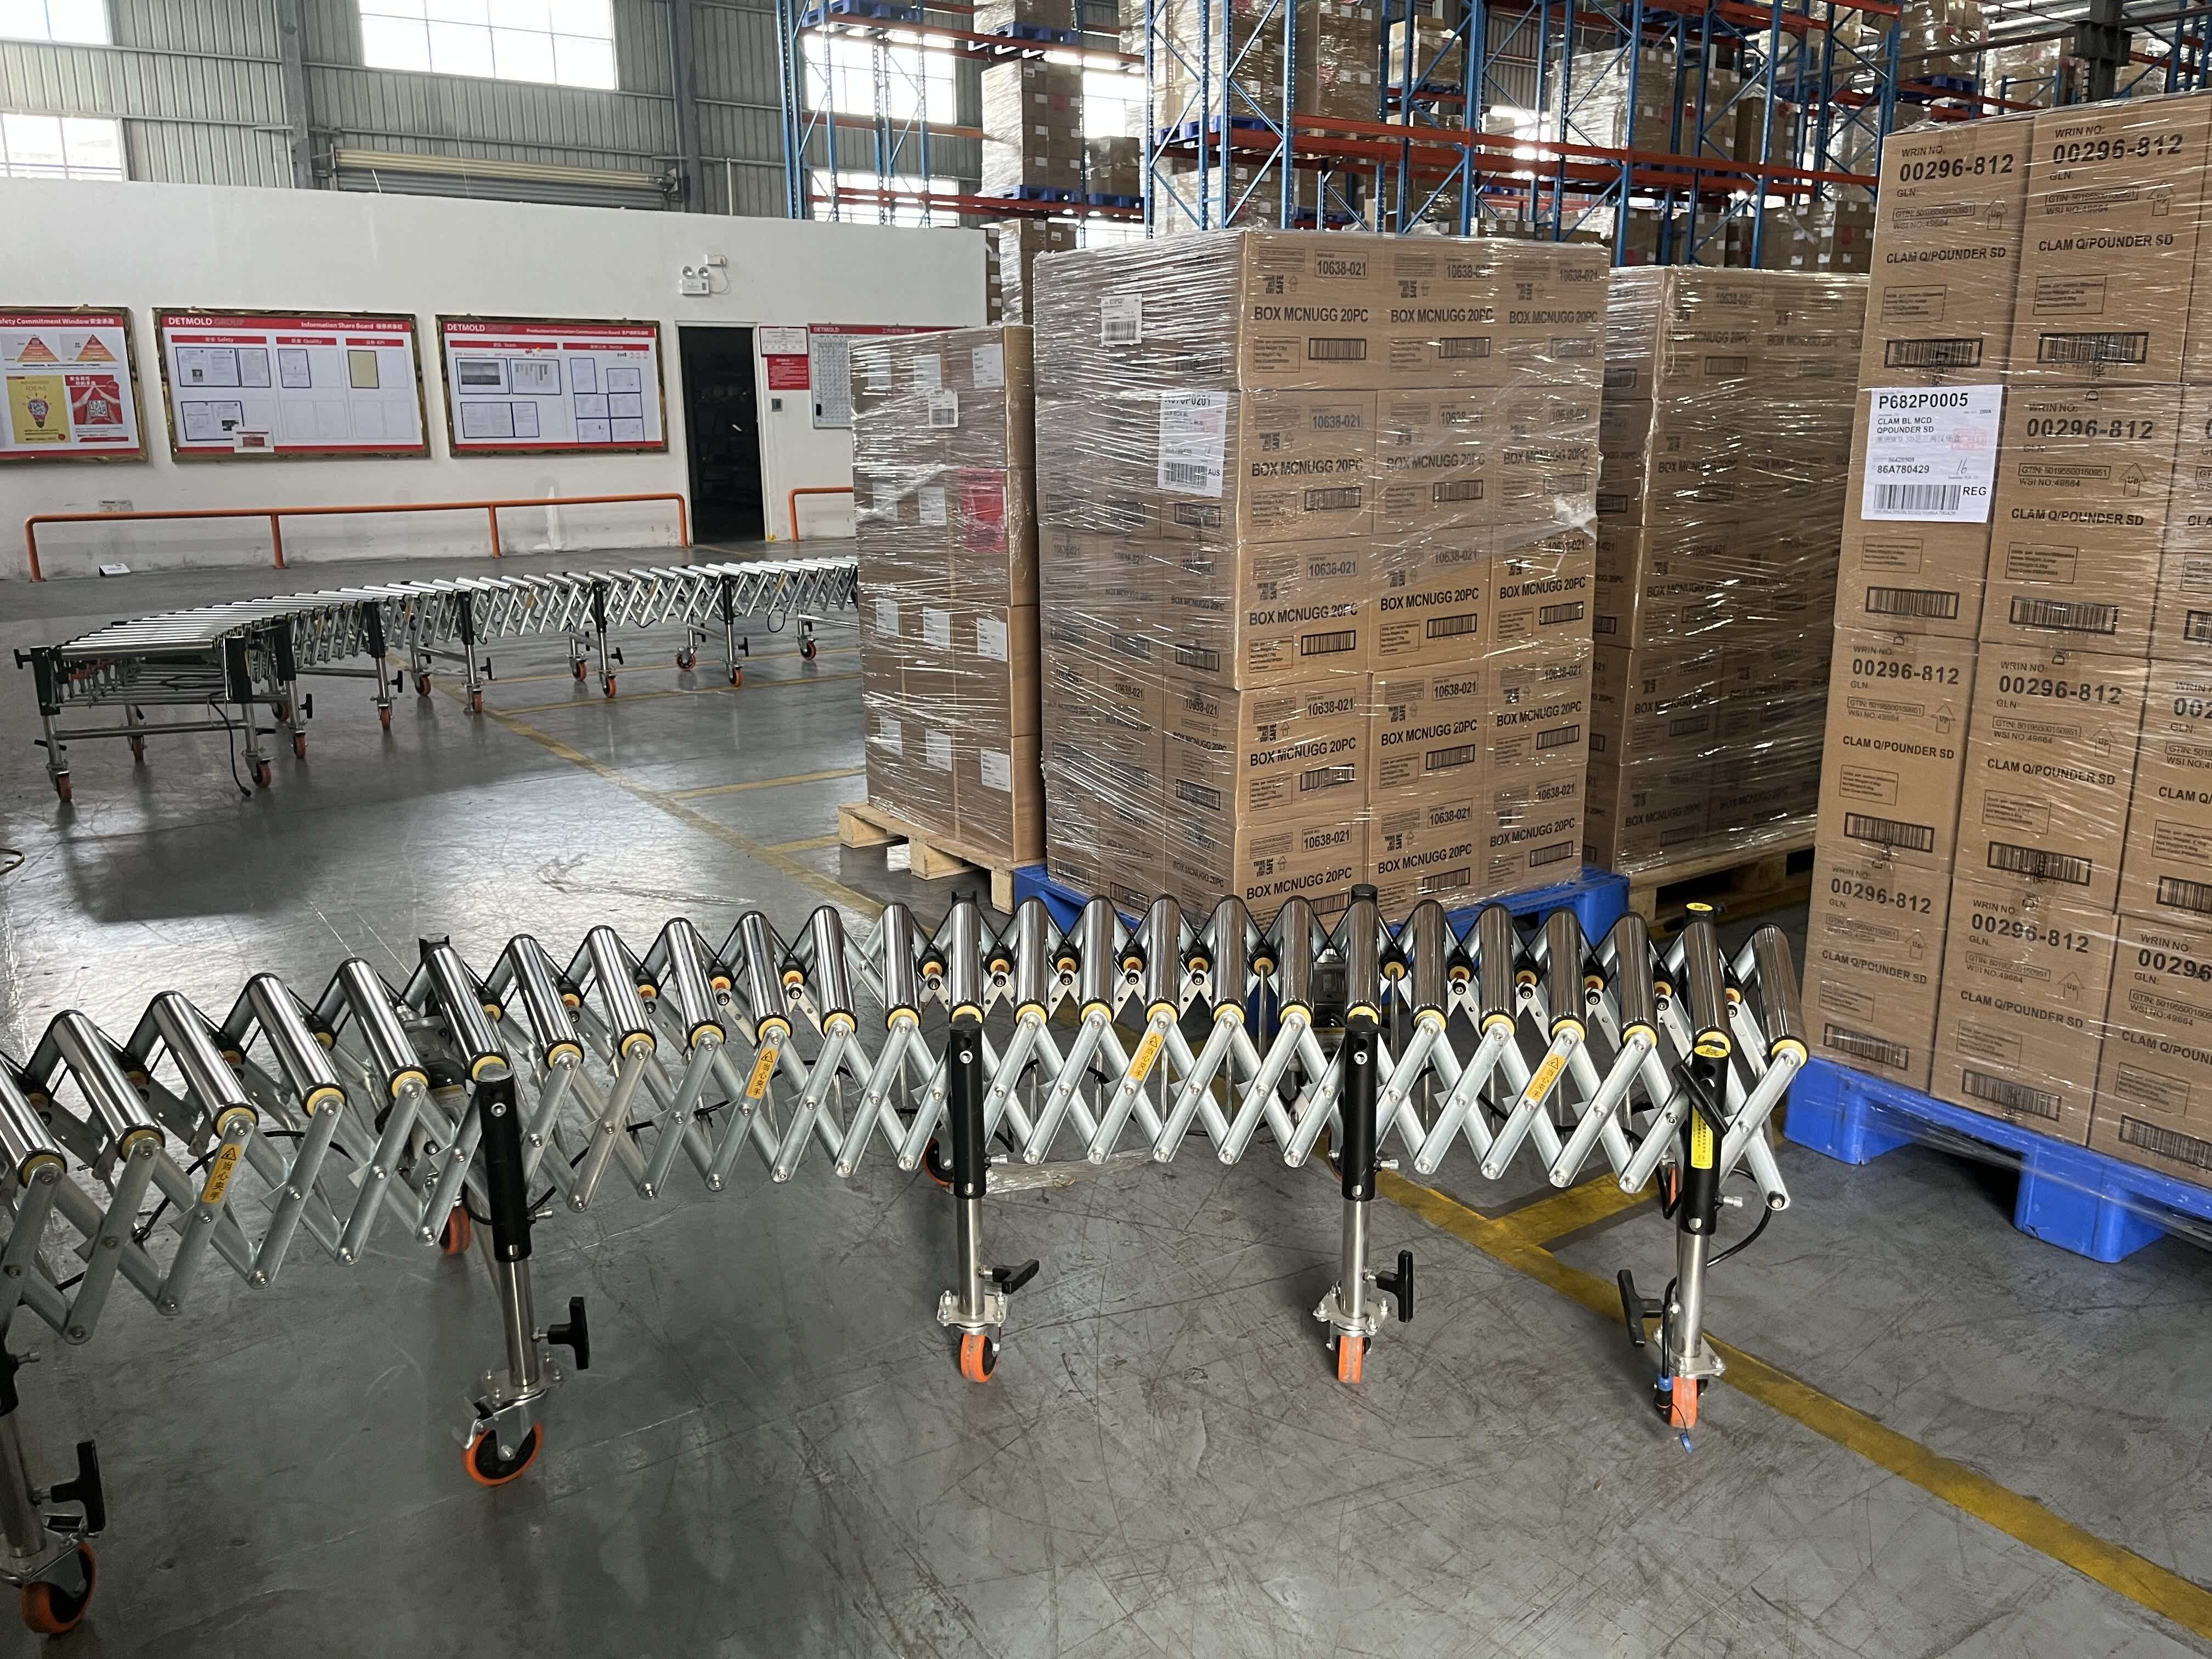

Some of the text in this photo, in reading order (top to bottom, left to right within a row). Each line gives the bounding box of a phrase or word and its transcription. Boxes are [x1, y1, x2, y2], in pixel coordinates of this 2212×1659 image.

[2055, 126, 2083, 138] WRIN
[1902, 148, 1927, 157] WRIN
[2053, 133, 2183, 165] 00296-812
[1900, 154, 2014, 183] 00296-812
[2039, 234, 2174, 251] CLAM Q/POUNDER SD
[1887, 247, 2006, 263] CLAM Q/POUNDER SD
[1317, 260, 1366, 276] 10638-021
[168, 317, 212, 325] DETMOLD
[1255, 307, 1369, 322] BOX MCNUGG 20PC
[1391, 309, 1415, 323] BOX
[1417, 309, 1465, 323] MCNUGG
[1509, 311, 1598, 324] BOX MCNUGG 20PC
[447, 324, 486, 332] DETMOLD
[1879, 392, 1969, 409] P682P0005
[1313, 415, 1361, 428] 10638-021
[2026, 417, 2154, 439] 00296-812
[1252, 462, 1278, 477] BOX
[1281, 460, 1333, 475] MCNUGG
[1413, 454, 1459, 469] MCNUGG
[1877, 465, 1929, 474] 86A780429
[1208, 469, 1220, 477] AUS
[1963, 486, 1987, 496] REG
[2012, 508, 2145, 526] CLAM Q/POUNDER SD
[1435, 550, 1477, 564] 10638-021
[1310, 561, 1356, 576] 10638-021
[1500, 577, 1585, 599] BOX MCNUGG 20PC
[1647, 585, 1666, 597] BOX
[1381, 588, 1479, 611] BOX MCNUGG 20PC
[1250, 610, 1275, 625] BOX
[1278, 606, 1329, 623] MCNUGG
[1853, 646, 1877, 654] WRIN
[1853, 658, 1959, 685] 00296-812
[2001, 662, 2027, 671] WRIN
[1435, 681, 1476, 698] 10638-021
[1999, 675, 2122, 705] 00296-812
[1308, 697, 1353, 716] 10638-021
[1497, 701, 1582, 727] BOX MCNUGG 20PC
[1635, 700, 1653, 714] BOX
[1381, 719, 1477, 746] BOX MCNUGG 20PC
[1251, 737, 1356, 766] BOX MCNUGG 20PC
[1843, 736, 1955, 759] CLAM Q/POUNDER SD
[1988, 759, 2115, 785] CLAM Q/POUNDER SD
[1538, 783, 1575, 801] 10638-021
[2159, 787, 2196, 801] CLAM
[1430, 807, 1471, 826] 10638-021
[1626, 814, 1645, 827] BOX
[1304, 829, 1350, 849] 10638-021
[1490, 818, 1576, 847] BOX MCNUGG 20PC
[1378, 843, 1472, 874] BOX MCNUGG 20PC
[1246, 867, 1352, 900] BOX MCNUGG 20PC
[1831, 878, 1932, 914] 00296-812
[1973, 899, 1999, 911] WRIN
[1972, 913, 2089, 953] 00296-812
[2141, 934, 2170, 948] WRIN
[1822, 950, 1927, 984] CLAM Q/POUNDER SD
[1961, 990, 2083, 1028] CLAM Q/POUNDER SD
[2121, 1031, 2156, 1049] CLAM
[753, 1063, 770, 1096] 当心夹手
[210, 1161, 233, 1200] 当心夹手
